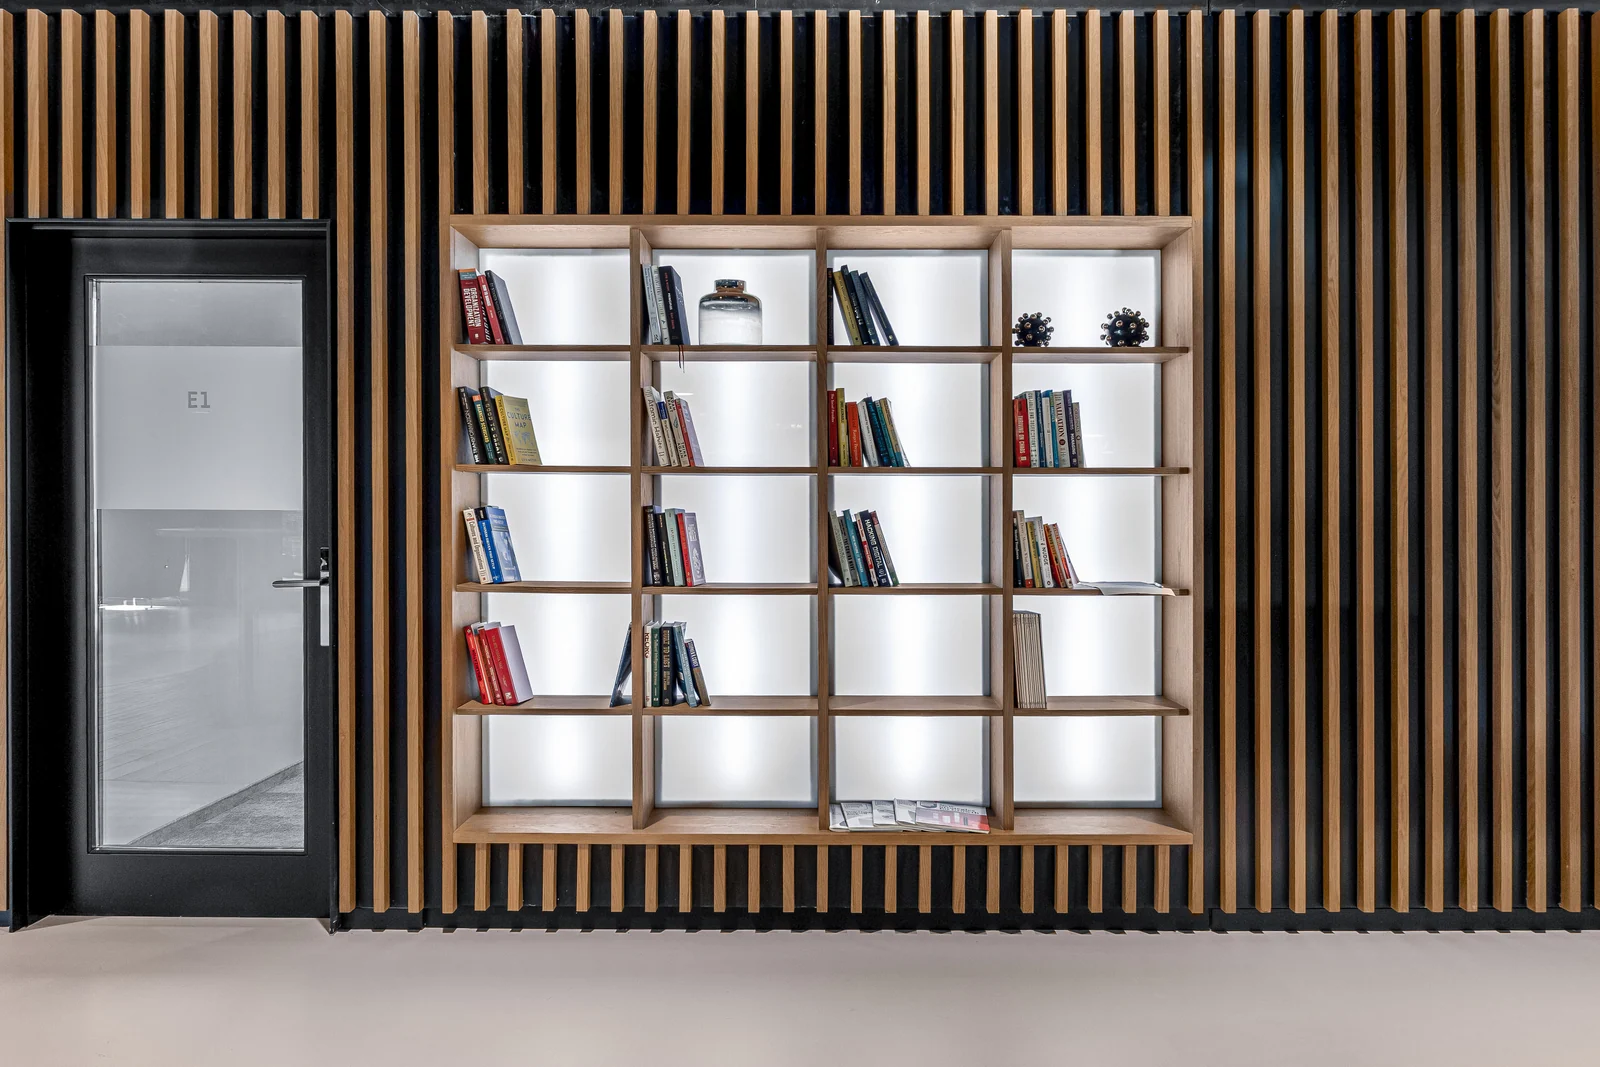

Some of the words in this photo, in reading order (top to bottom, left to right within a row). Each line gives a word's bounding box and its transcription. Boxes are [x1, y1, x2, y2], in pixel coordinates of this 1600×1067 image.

[463, 288, 475, 327] DEVELOPMENT
[471, 288, 481, 327] ORGANIZATION
[188, 391, 210, 408] E1
[485, 403, 493, 421] GOOD
[490, 422, 496, 431] TO
[499, 407, 507, 426] CULTURE
[507, 411, 531, 421] CULTURE
[648, 399, 657, 425] Atomic
[653, 426, 662, 449] Habits
[1056, 402, 1065, 437] VALUATION
[481, 422, 490, 443] SCORECARD
[468, 521, 476, 537] Cultures
[473, 544, 484, 570] Organizations
[864, 519, 877, 546] HACKING
[872, 545, 883, 568] DIGITAL
[1041, 547, 1049, 565] NUDGE
